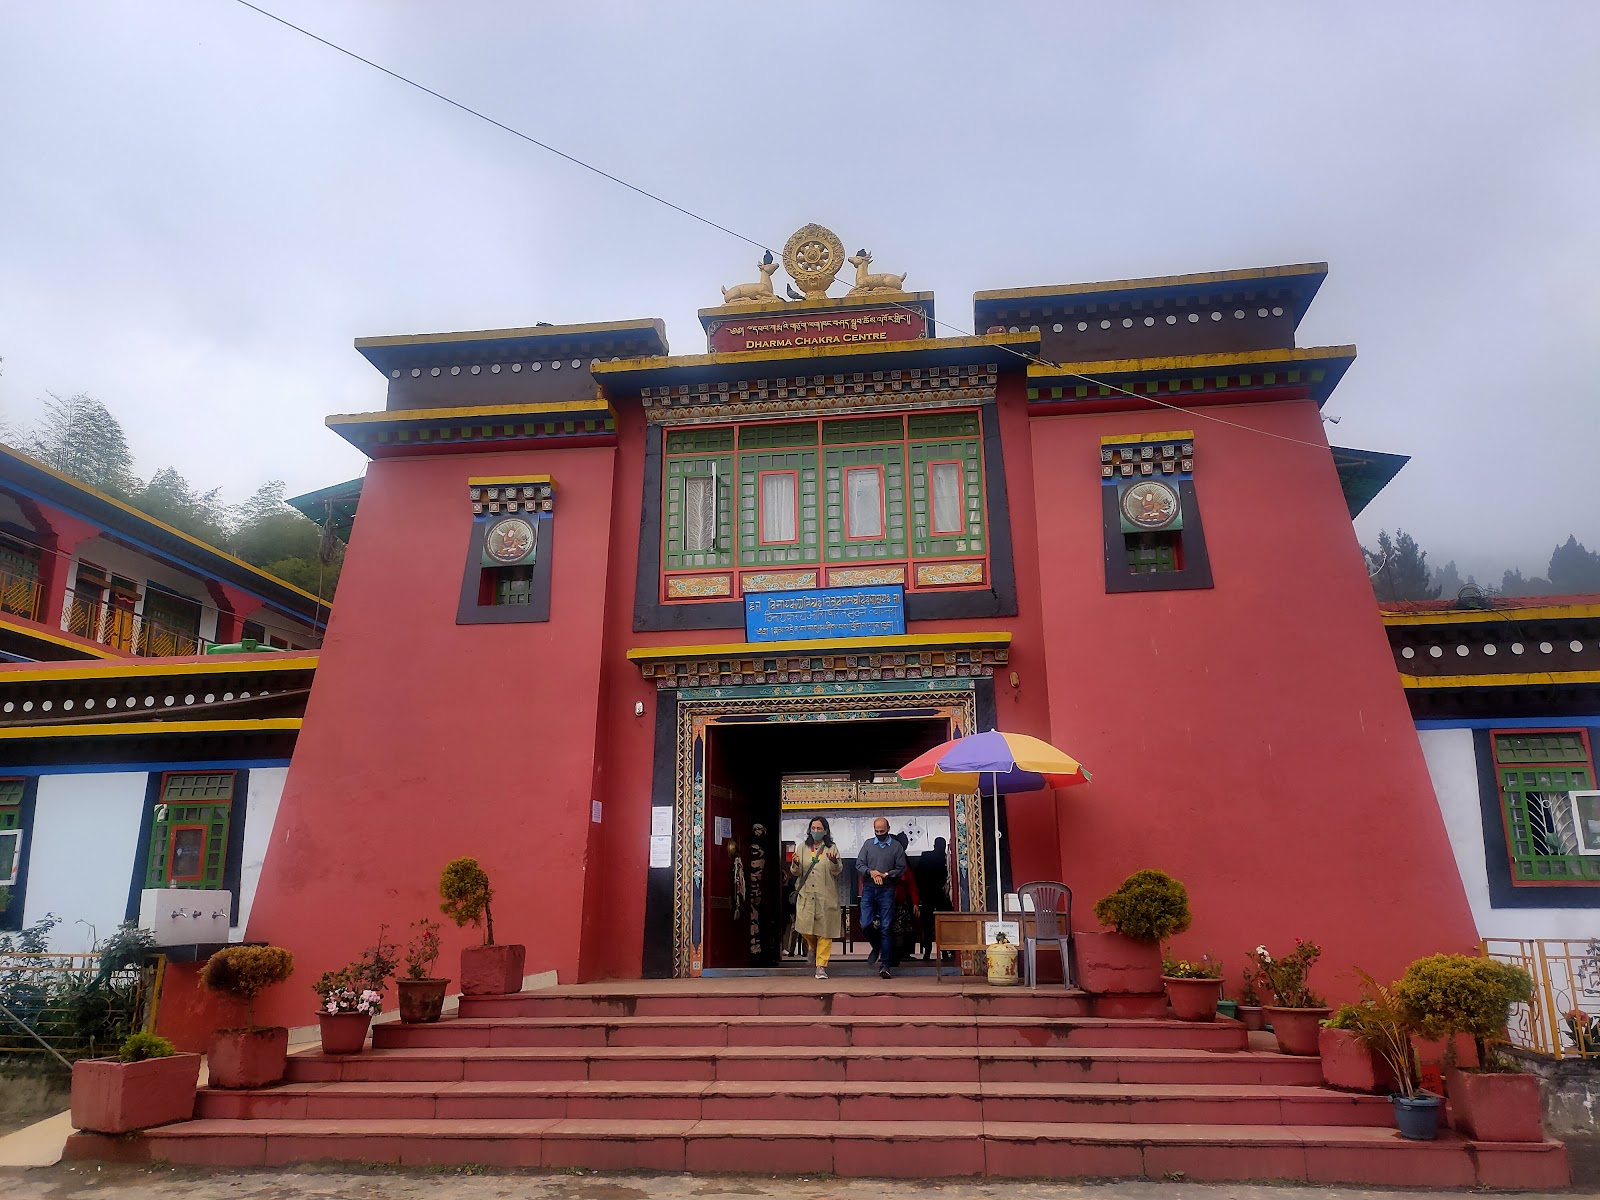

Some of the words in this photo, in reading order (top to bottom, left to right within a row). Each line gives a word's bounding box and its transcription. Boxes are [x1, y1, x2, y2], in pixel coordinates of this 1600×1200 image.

[745, 339, 793, 349] DHARMA
[794, 333, 840, 345] CHAKRA
[843, 331, 887, 343] CENTRE
